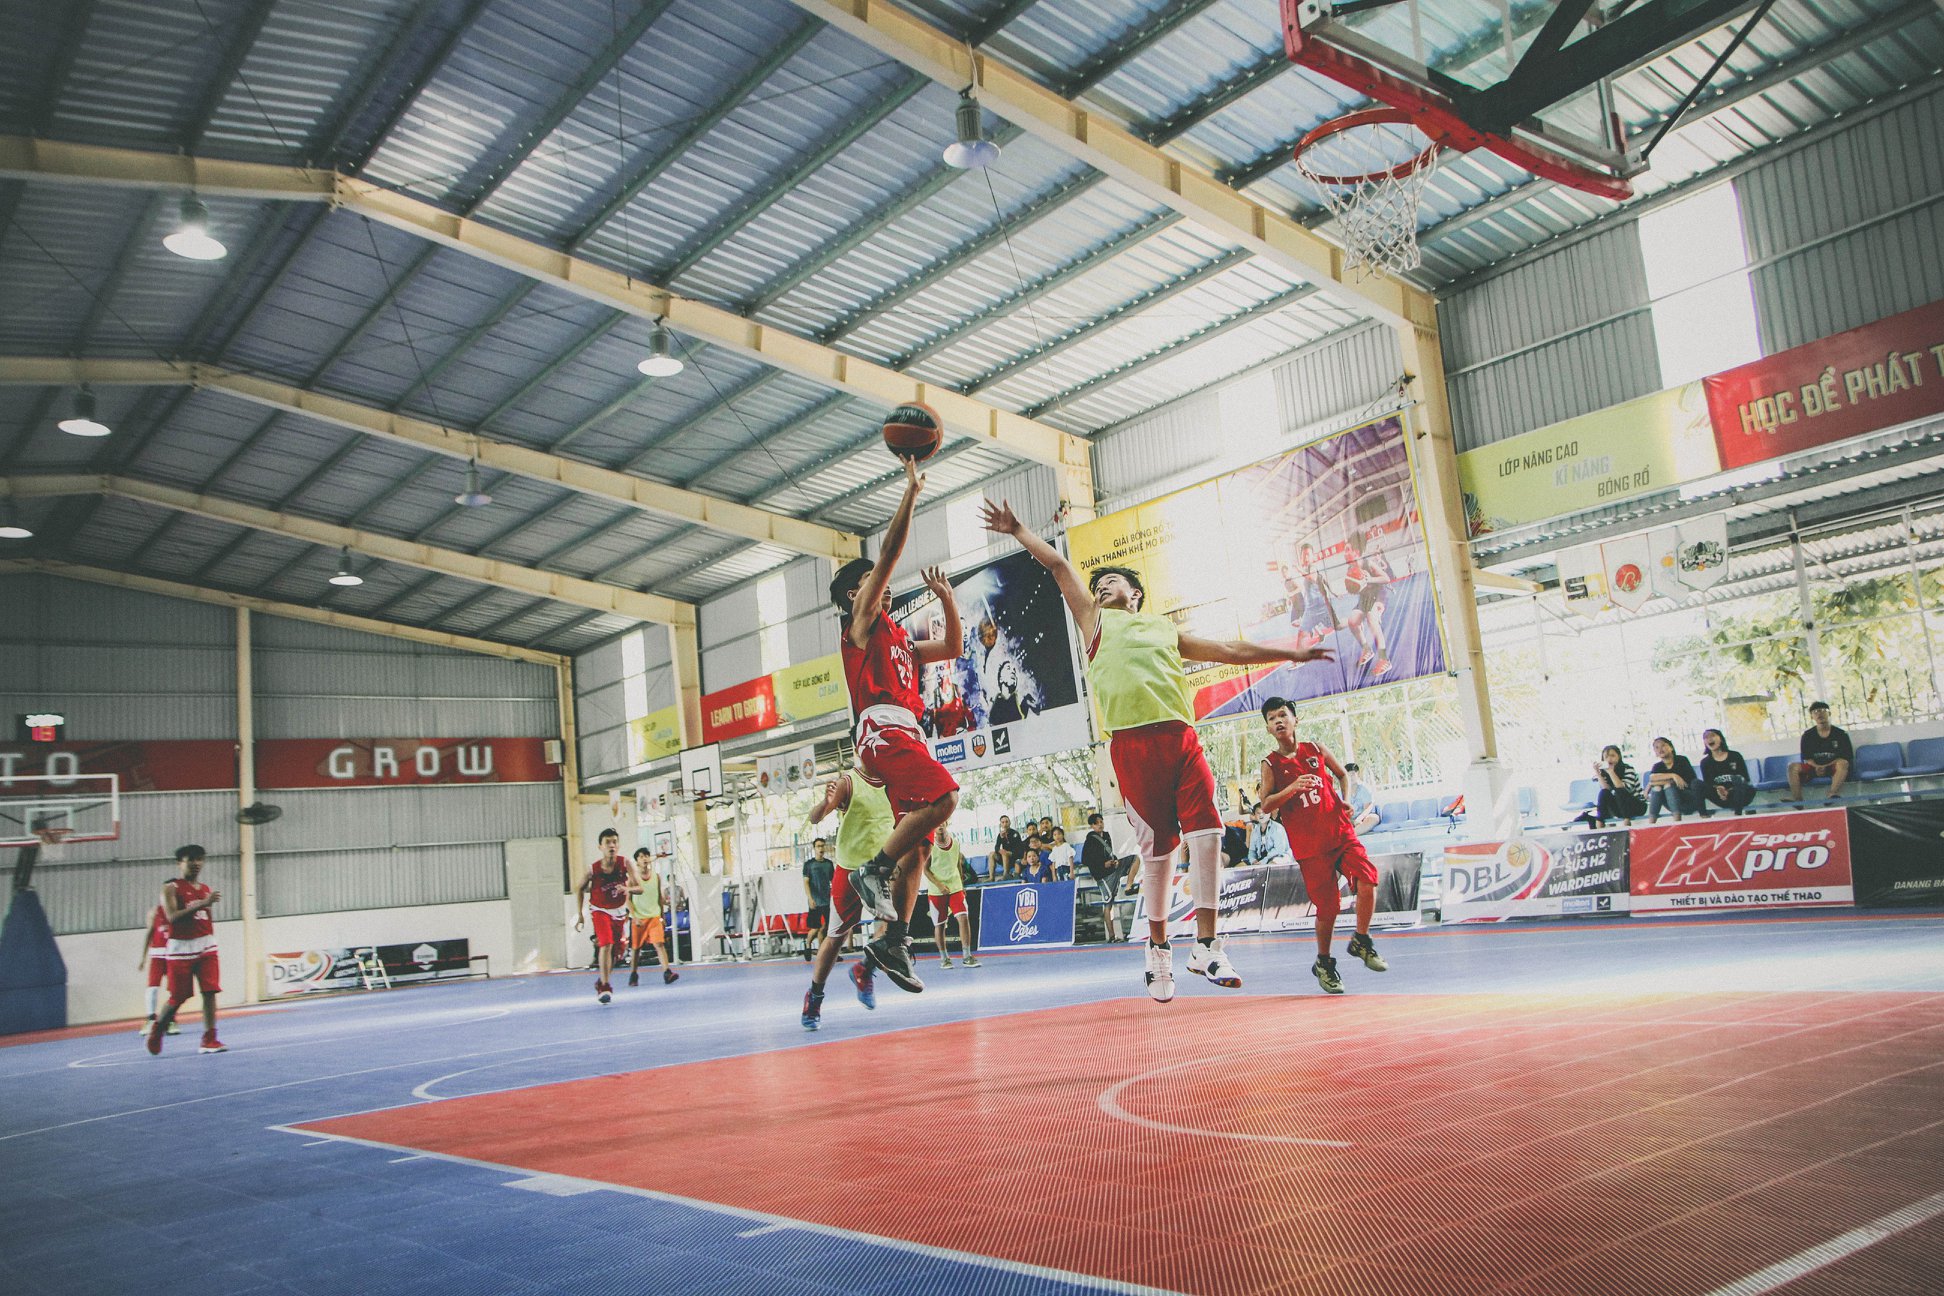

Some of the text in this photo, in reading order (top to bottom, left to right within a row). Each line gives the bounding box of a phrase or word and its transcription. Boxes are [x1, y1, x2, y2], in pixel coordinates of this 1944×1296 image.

[1738, 391, 1798, 435] HỌC
[1800, 365, 1841, 418] ĐỂ
[1843, 351, 1923, 406] PHÁT
[1498, 440, 1579, 478] LỚP NÂNG CAO
[1597, 464, 1650, 498] BÓNG RỔ
[328, 745, 494, 779] GROW
[937, 742, 963, 758] molten
[1299, 788, 1322, 809] 16
[1741, 845, 1830, 880] pro
[1225, 878, 1252, 894] JOKER
[1450, 862, 1512, 895] DBL
[1548, 868, 1621, 896] WARDERING
[1018, 891, 1035, 907] VBA
[1670, 894, 1697, 906] THIẾT
[1698, 896, 1708, 907] BỊ
[1709, 894, 1723, 905] VÀ
[1724, 893, 1745, 904] ĐÀO
[1747, 893, 1768, 905] TẠO
[1792, 891, 1822, 901] THAO
